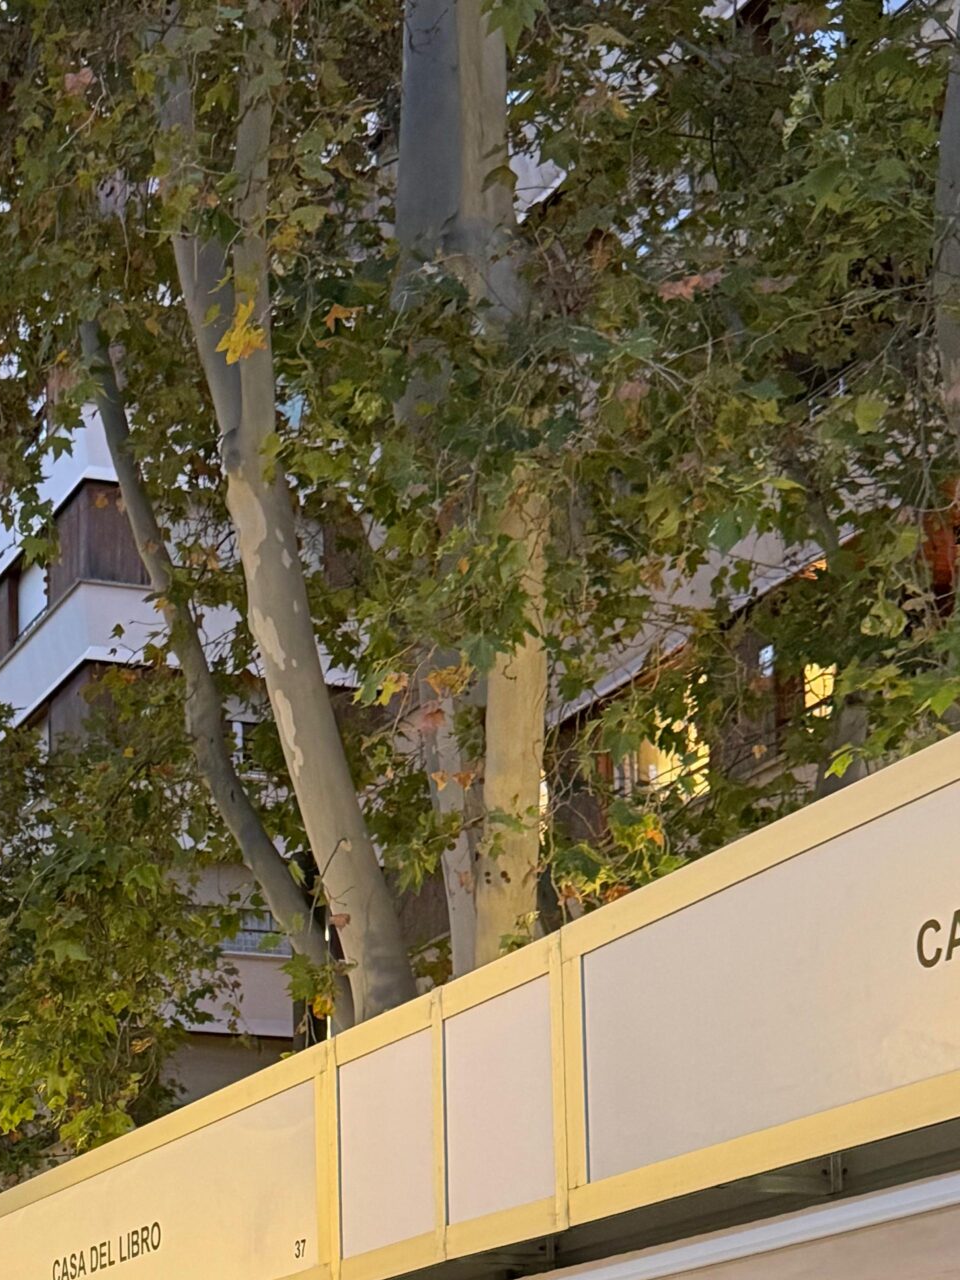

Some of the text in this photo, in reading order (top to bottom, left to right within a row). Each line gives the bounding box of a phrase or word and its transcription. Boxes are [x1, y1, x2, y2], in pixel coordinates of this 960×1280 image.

[917, 908, 960, 969] CA
[90, 1240, 116, 1273] DEL
[119, 1221, 161, 1263] LIBRO
[294, 1238, 307, 1259] 37
